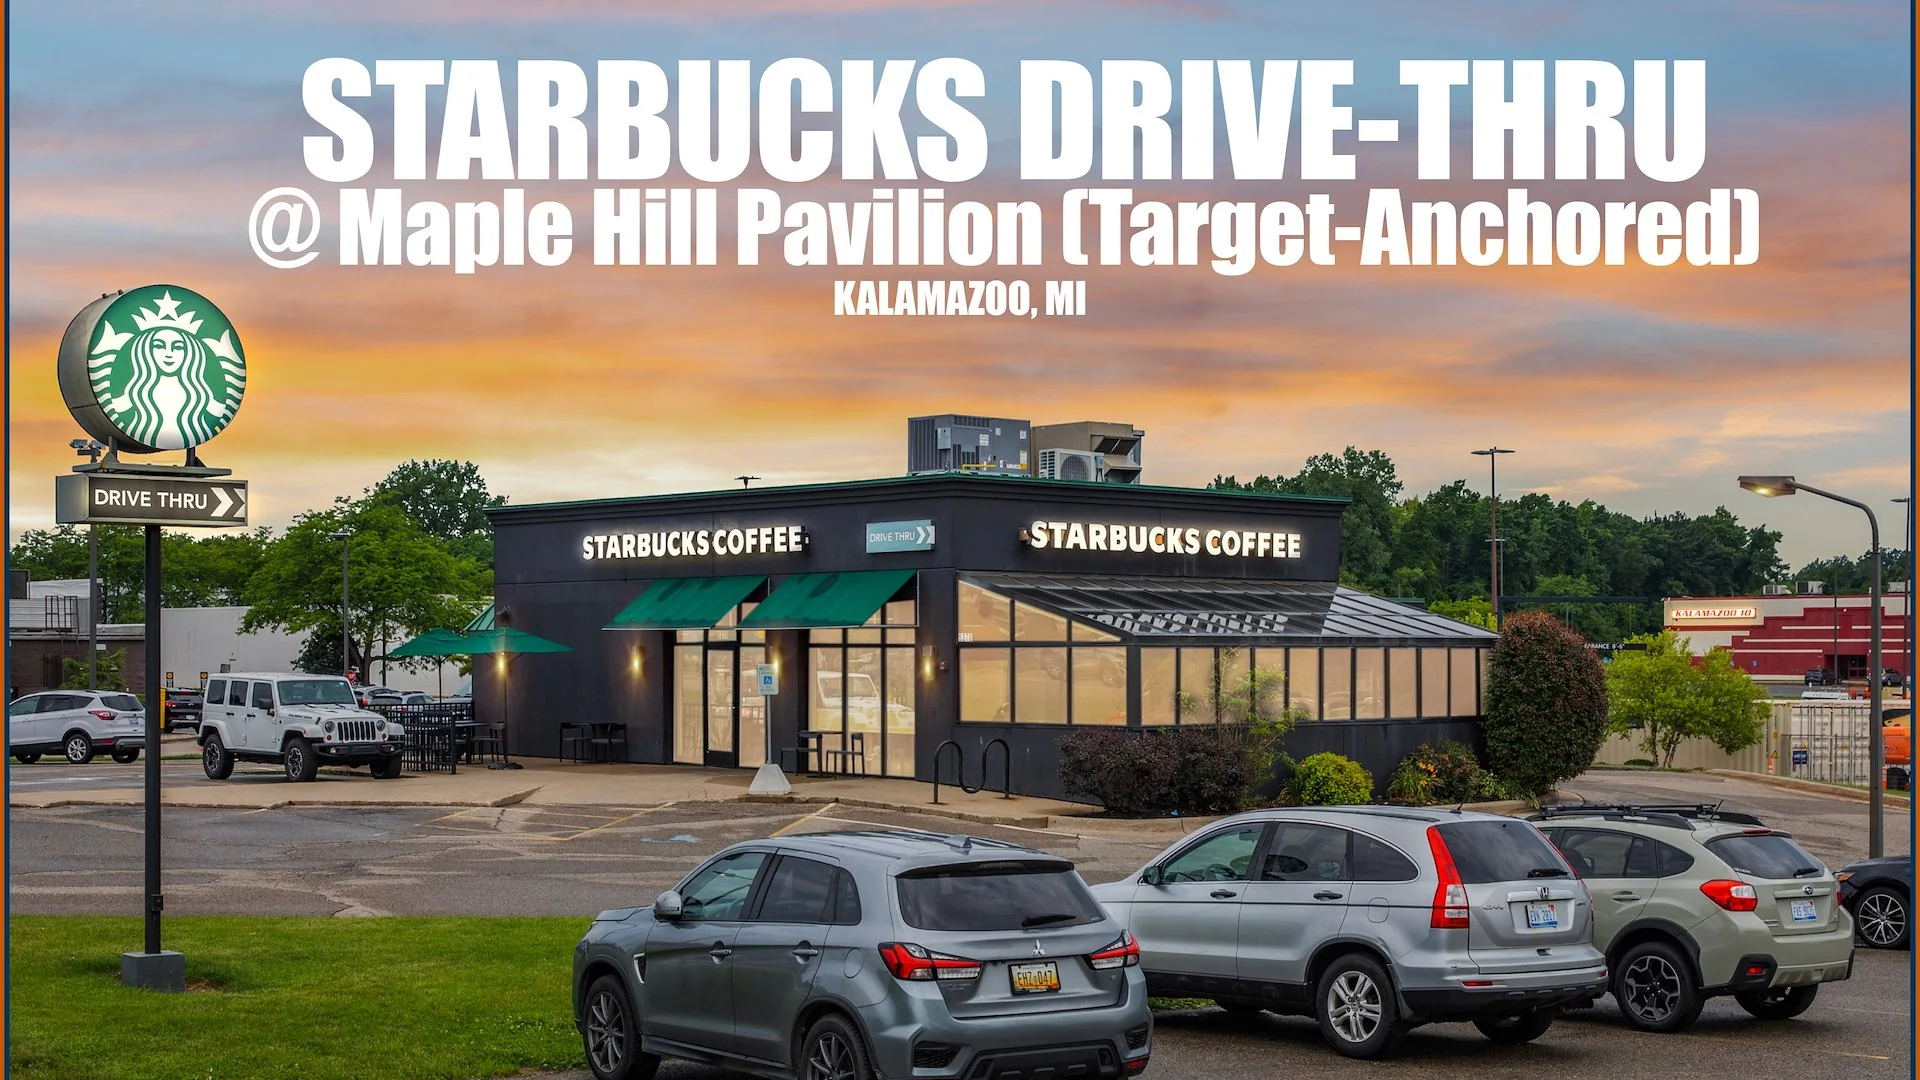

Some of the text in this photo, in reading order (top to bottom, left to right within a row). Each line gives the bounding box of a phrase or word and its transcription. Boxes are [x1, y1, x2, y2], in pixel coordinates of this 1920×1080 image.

[94, 488, 208, 510] DRIVE THRU
[582, 525, 803, 560] STARBUCKS COFFEE
[870, 531, 915, 543] DRIVE THRU
[1030, 520, 1301, 559] STARBUCKS COFFEE
[1038, 970, 1052, 985] 047
